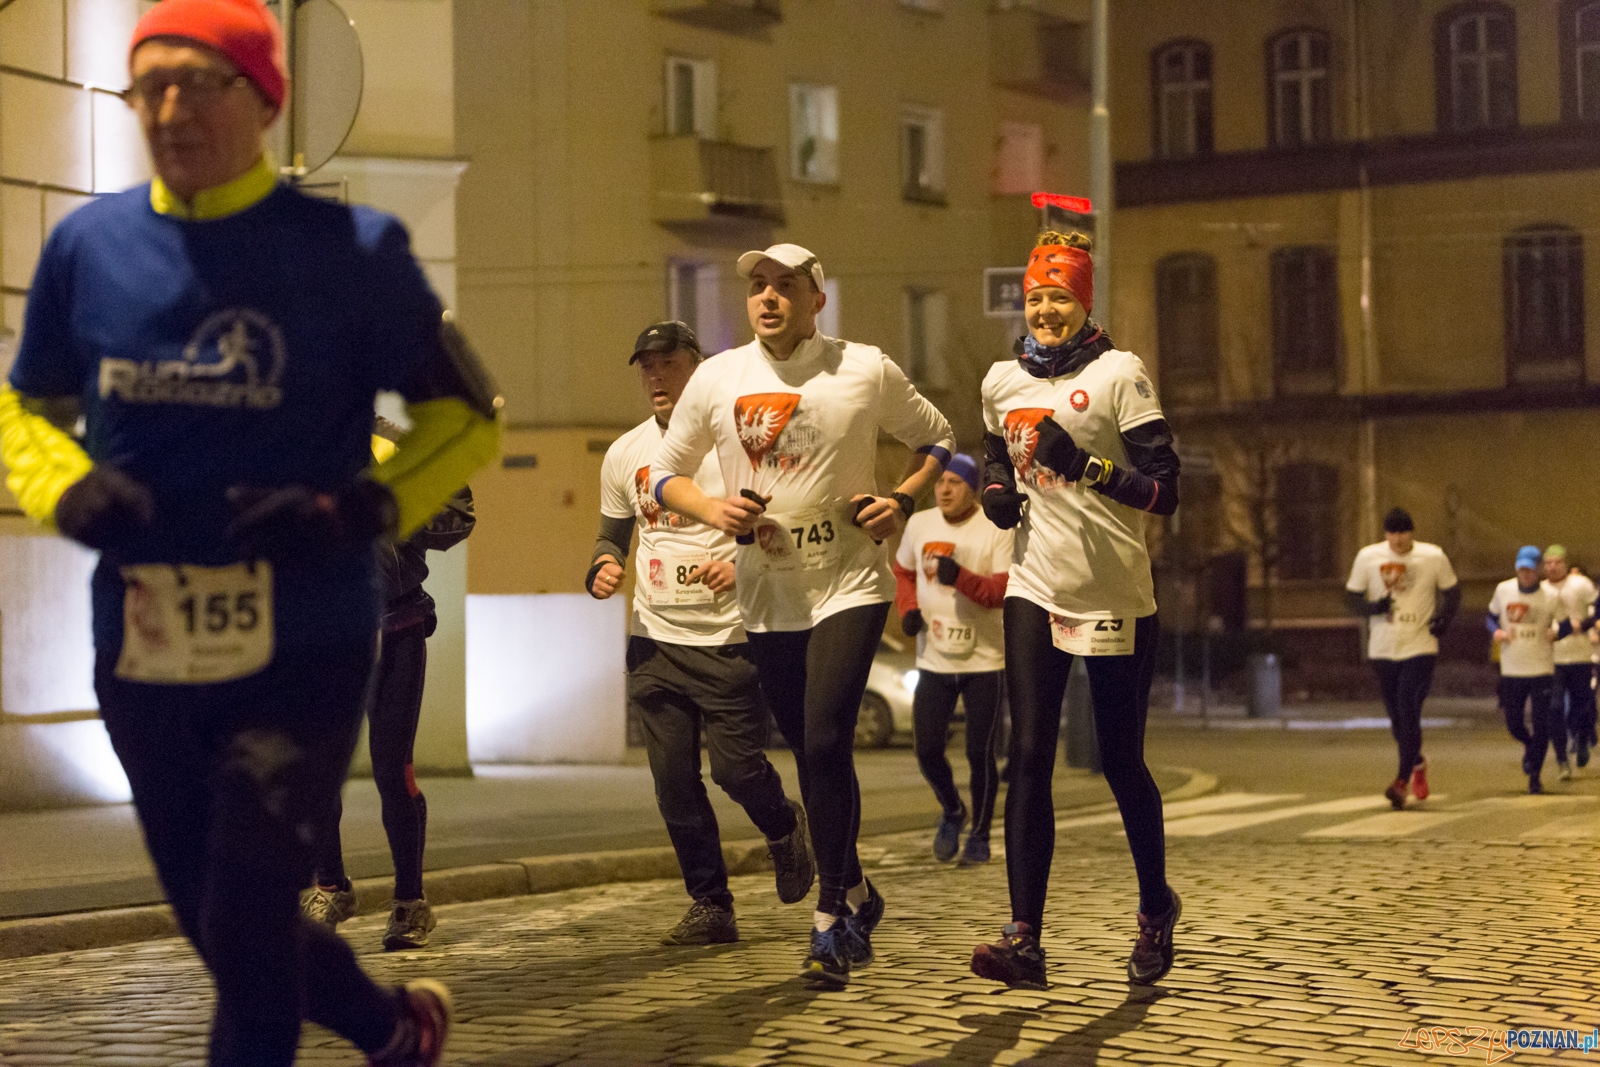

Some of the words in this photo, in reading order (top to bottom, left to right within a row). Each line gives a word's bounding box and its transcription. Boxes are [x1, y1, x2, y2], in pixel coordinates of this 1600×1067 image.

[790, 519, 835, 549] 743
[178, 589, 259, 636] 155
[947, 627, 972, 640] 778
